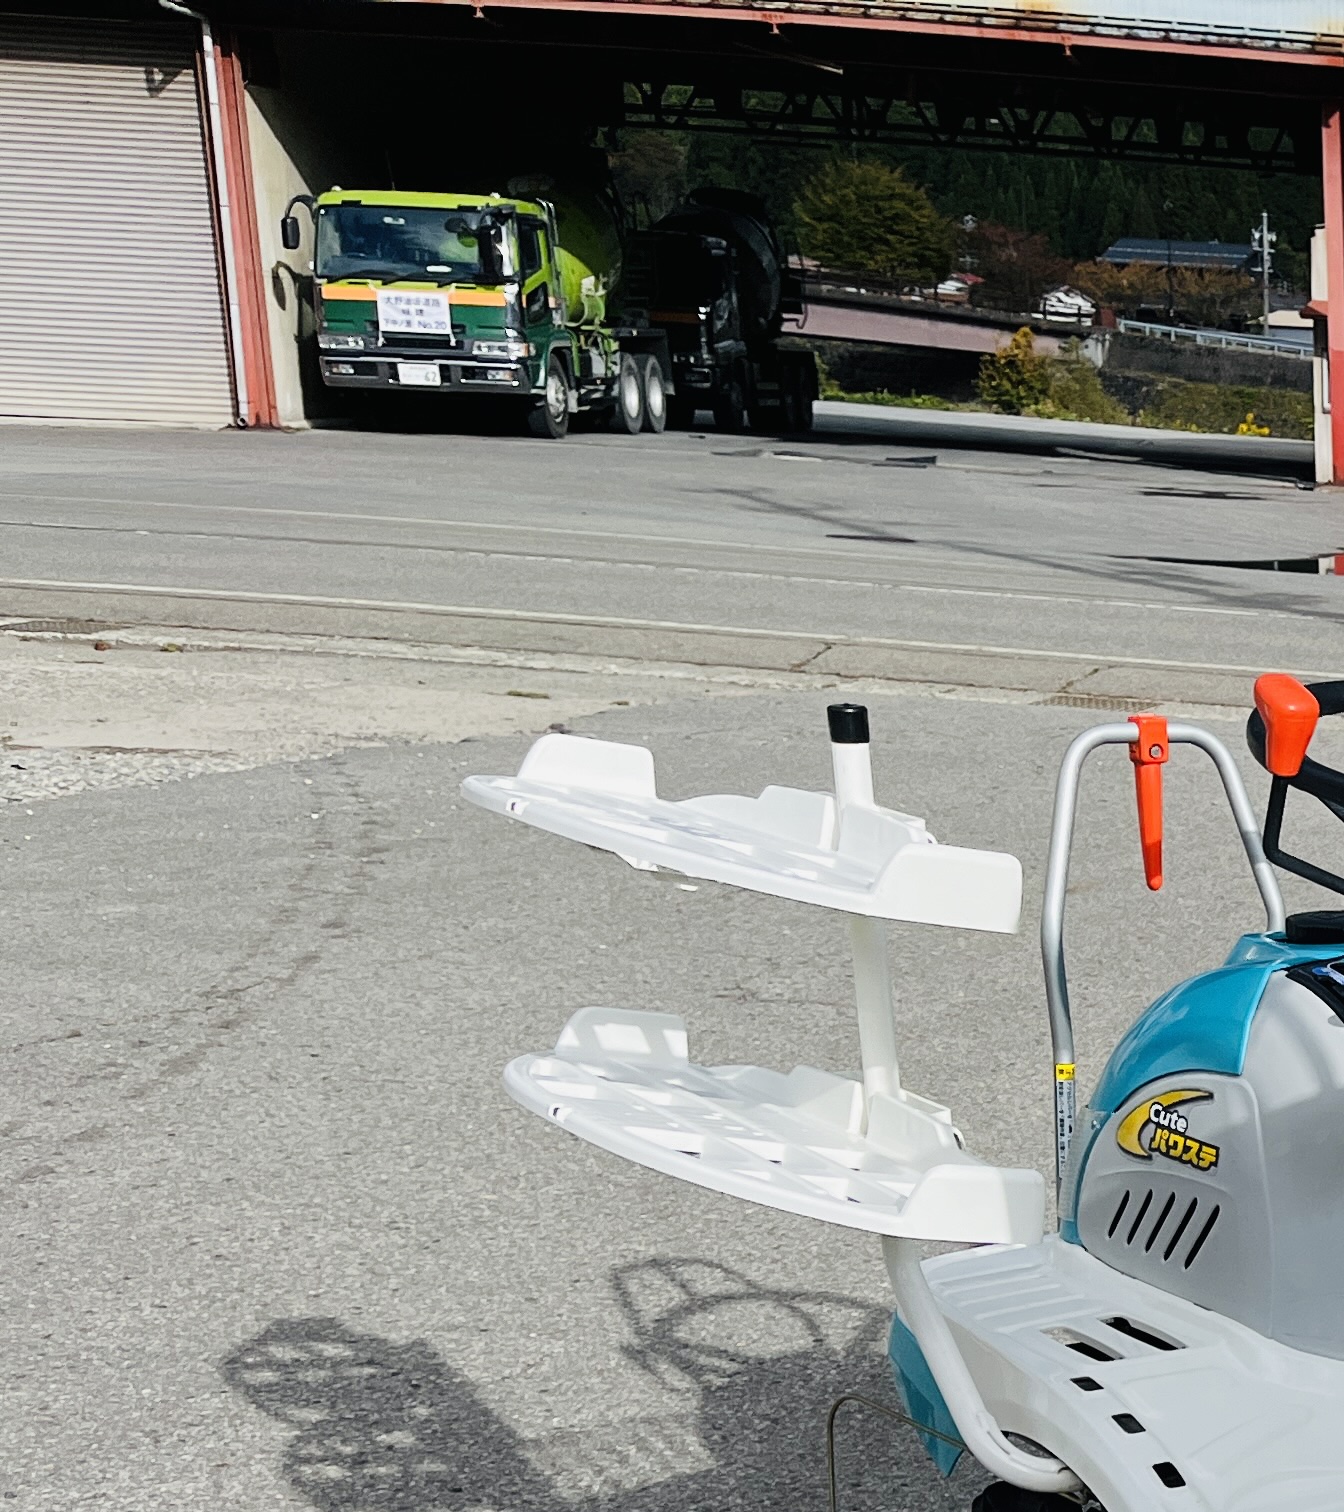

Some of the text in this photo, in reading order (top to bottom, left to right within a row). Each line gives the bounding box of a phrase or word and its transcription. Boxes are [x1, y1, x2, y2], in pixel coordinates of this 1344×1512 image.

[1150, 1103, 1187, 1133] Cute
[1151, 1128, 1217, 1168] パワステ
